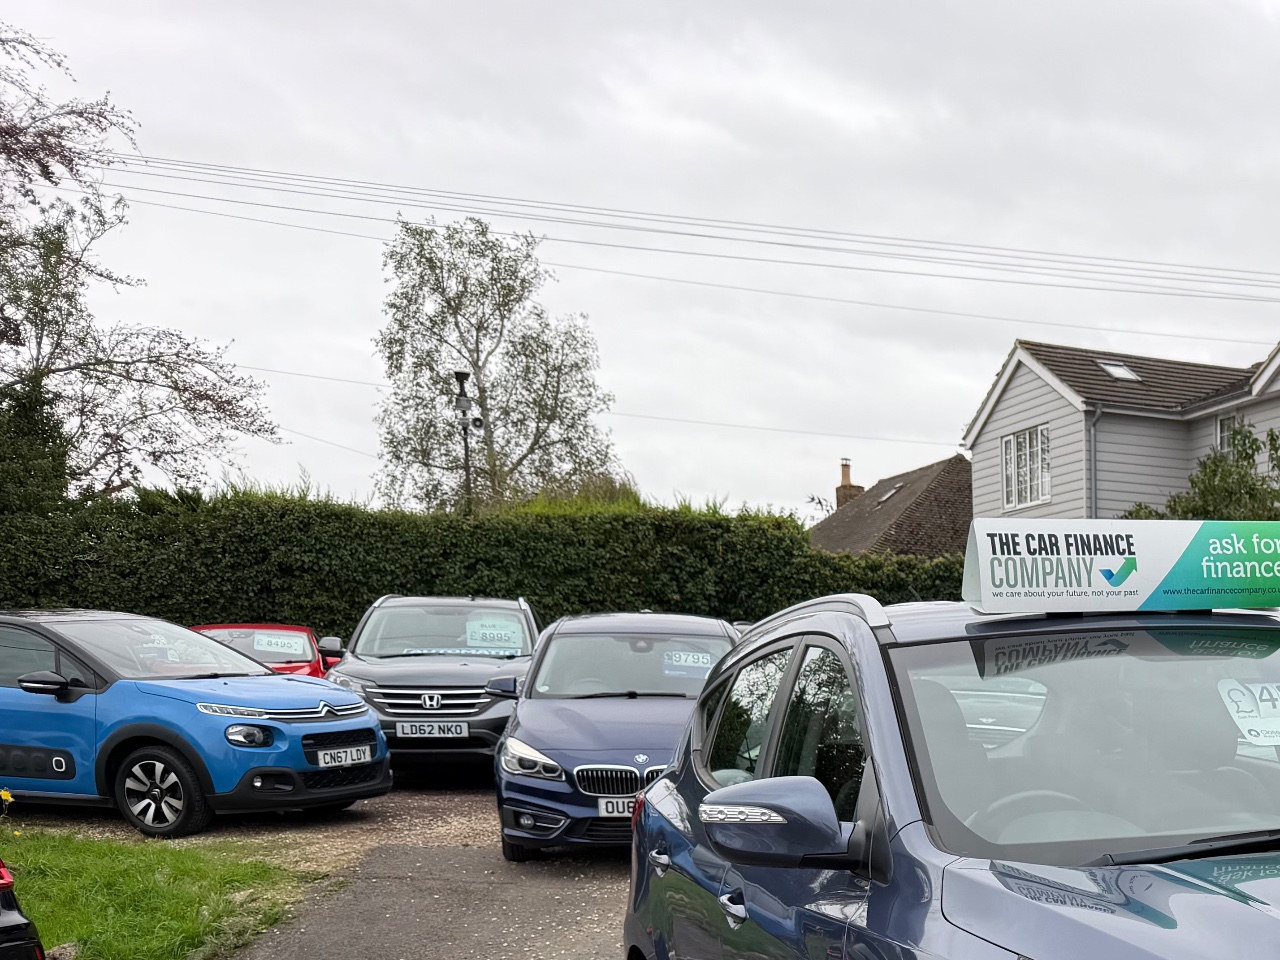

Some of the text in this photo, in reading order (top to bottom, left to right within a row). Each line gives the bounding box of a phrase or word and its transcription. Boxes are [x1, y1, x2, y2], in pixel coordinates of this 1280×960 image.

[987, 532, 1136, 556] THE CAR FINANCE
[1208, 533, 1248, 555] ask
[989, 556, 1095, 589] COMPANY
[1024, 589, 1046, 598] about
[1047, 591, 1065, 599] your
[1066, 589, 1090, 598] future,
[1106, 590, 1123, 599] your
[1124, 589, 1139, 599] past
[266, 639, 292, 648] 8495
[481, 632, 510, 642] 8995
[401, 724, 463, 736] LD62 NKO
[322, 747, 367, 766] CN67 LDY
